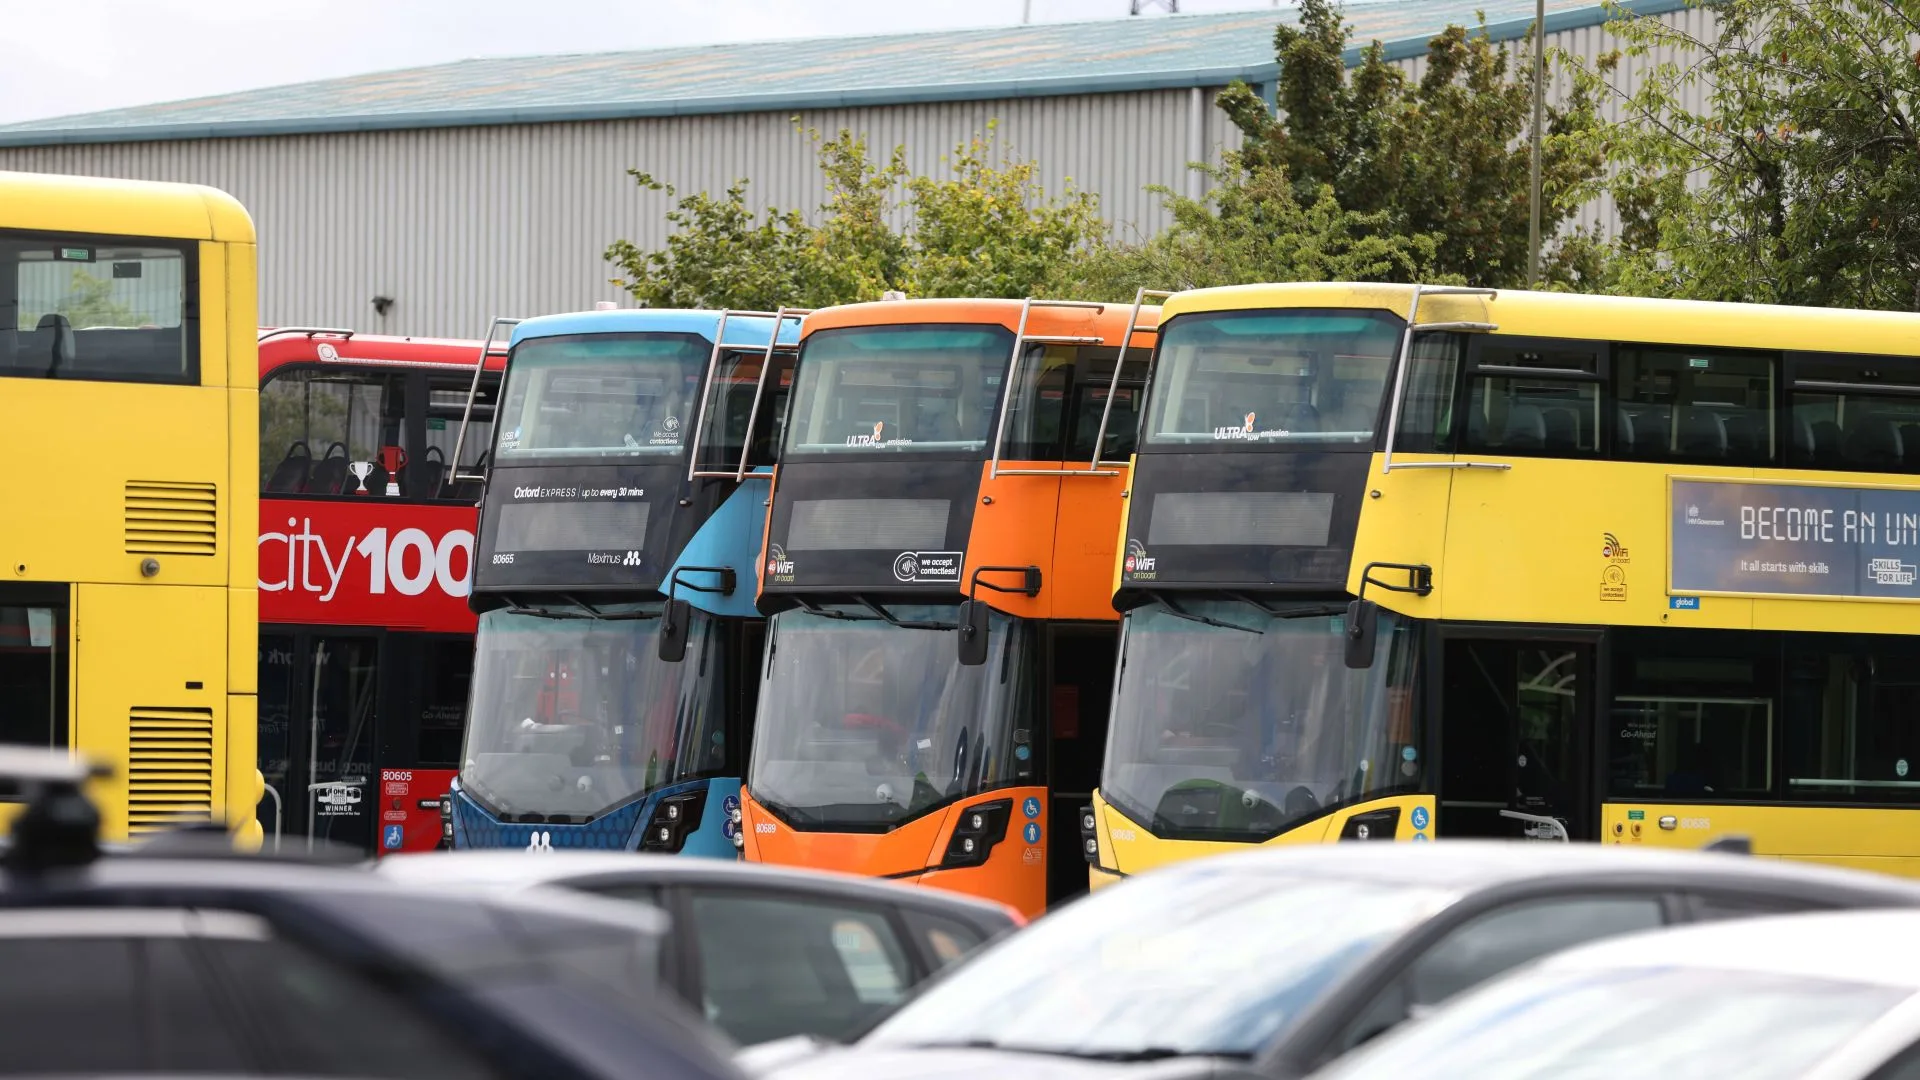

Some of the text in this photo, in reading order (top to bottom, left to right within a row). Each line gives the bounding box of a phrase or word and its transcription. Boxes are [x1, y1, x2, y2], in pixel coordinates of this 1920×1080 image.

[1214, 426, 1247, 440] ULTRA
[1260, 429, 1289, 437] emission
[846, 435, 876, 447] ULTRA
[887, 438, 912, 446] emission
[514, 486, 644, 499] Oxford EXPRESS up to every 30 mins
[1740, 506, 1920, 545] BECOME AN UN
[493, 554, 515, 564] 80665
[587, 552, 621, 564] Maximus
[931, 558, 952, 567] accept
[777, 561, 794, 573] WiFi
[1136, 558, 1155, 570] WiFi
[1741, 560, 1829, 574] It all starts with skills
[1873, 560, 1900, 570] SKILLS
[920, 567, 957, 575] contactless!
[1141, 571, 1156, 579] board
[1878, 573, 1911, 583] FOR LIFE
[1676, 598, 1694, 607] global
[1620, 730, 1656, 739] Go-Ahead
[382, 771, 412, 781] 80605
[756, 824, 776, 833] 80689
